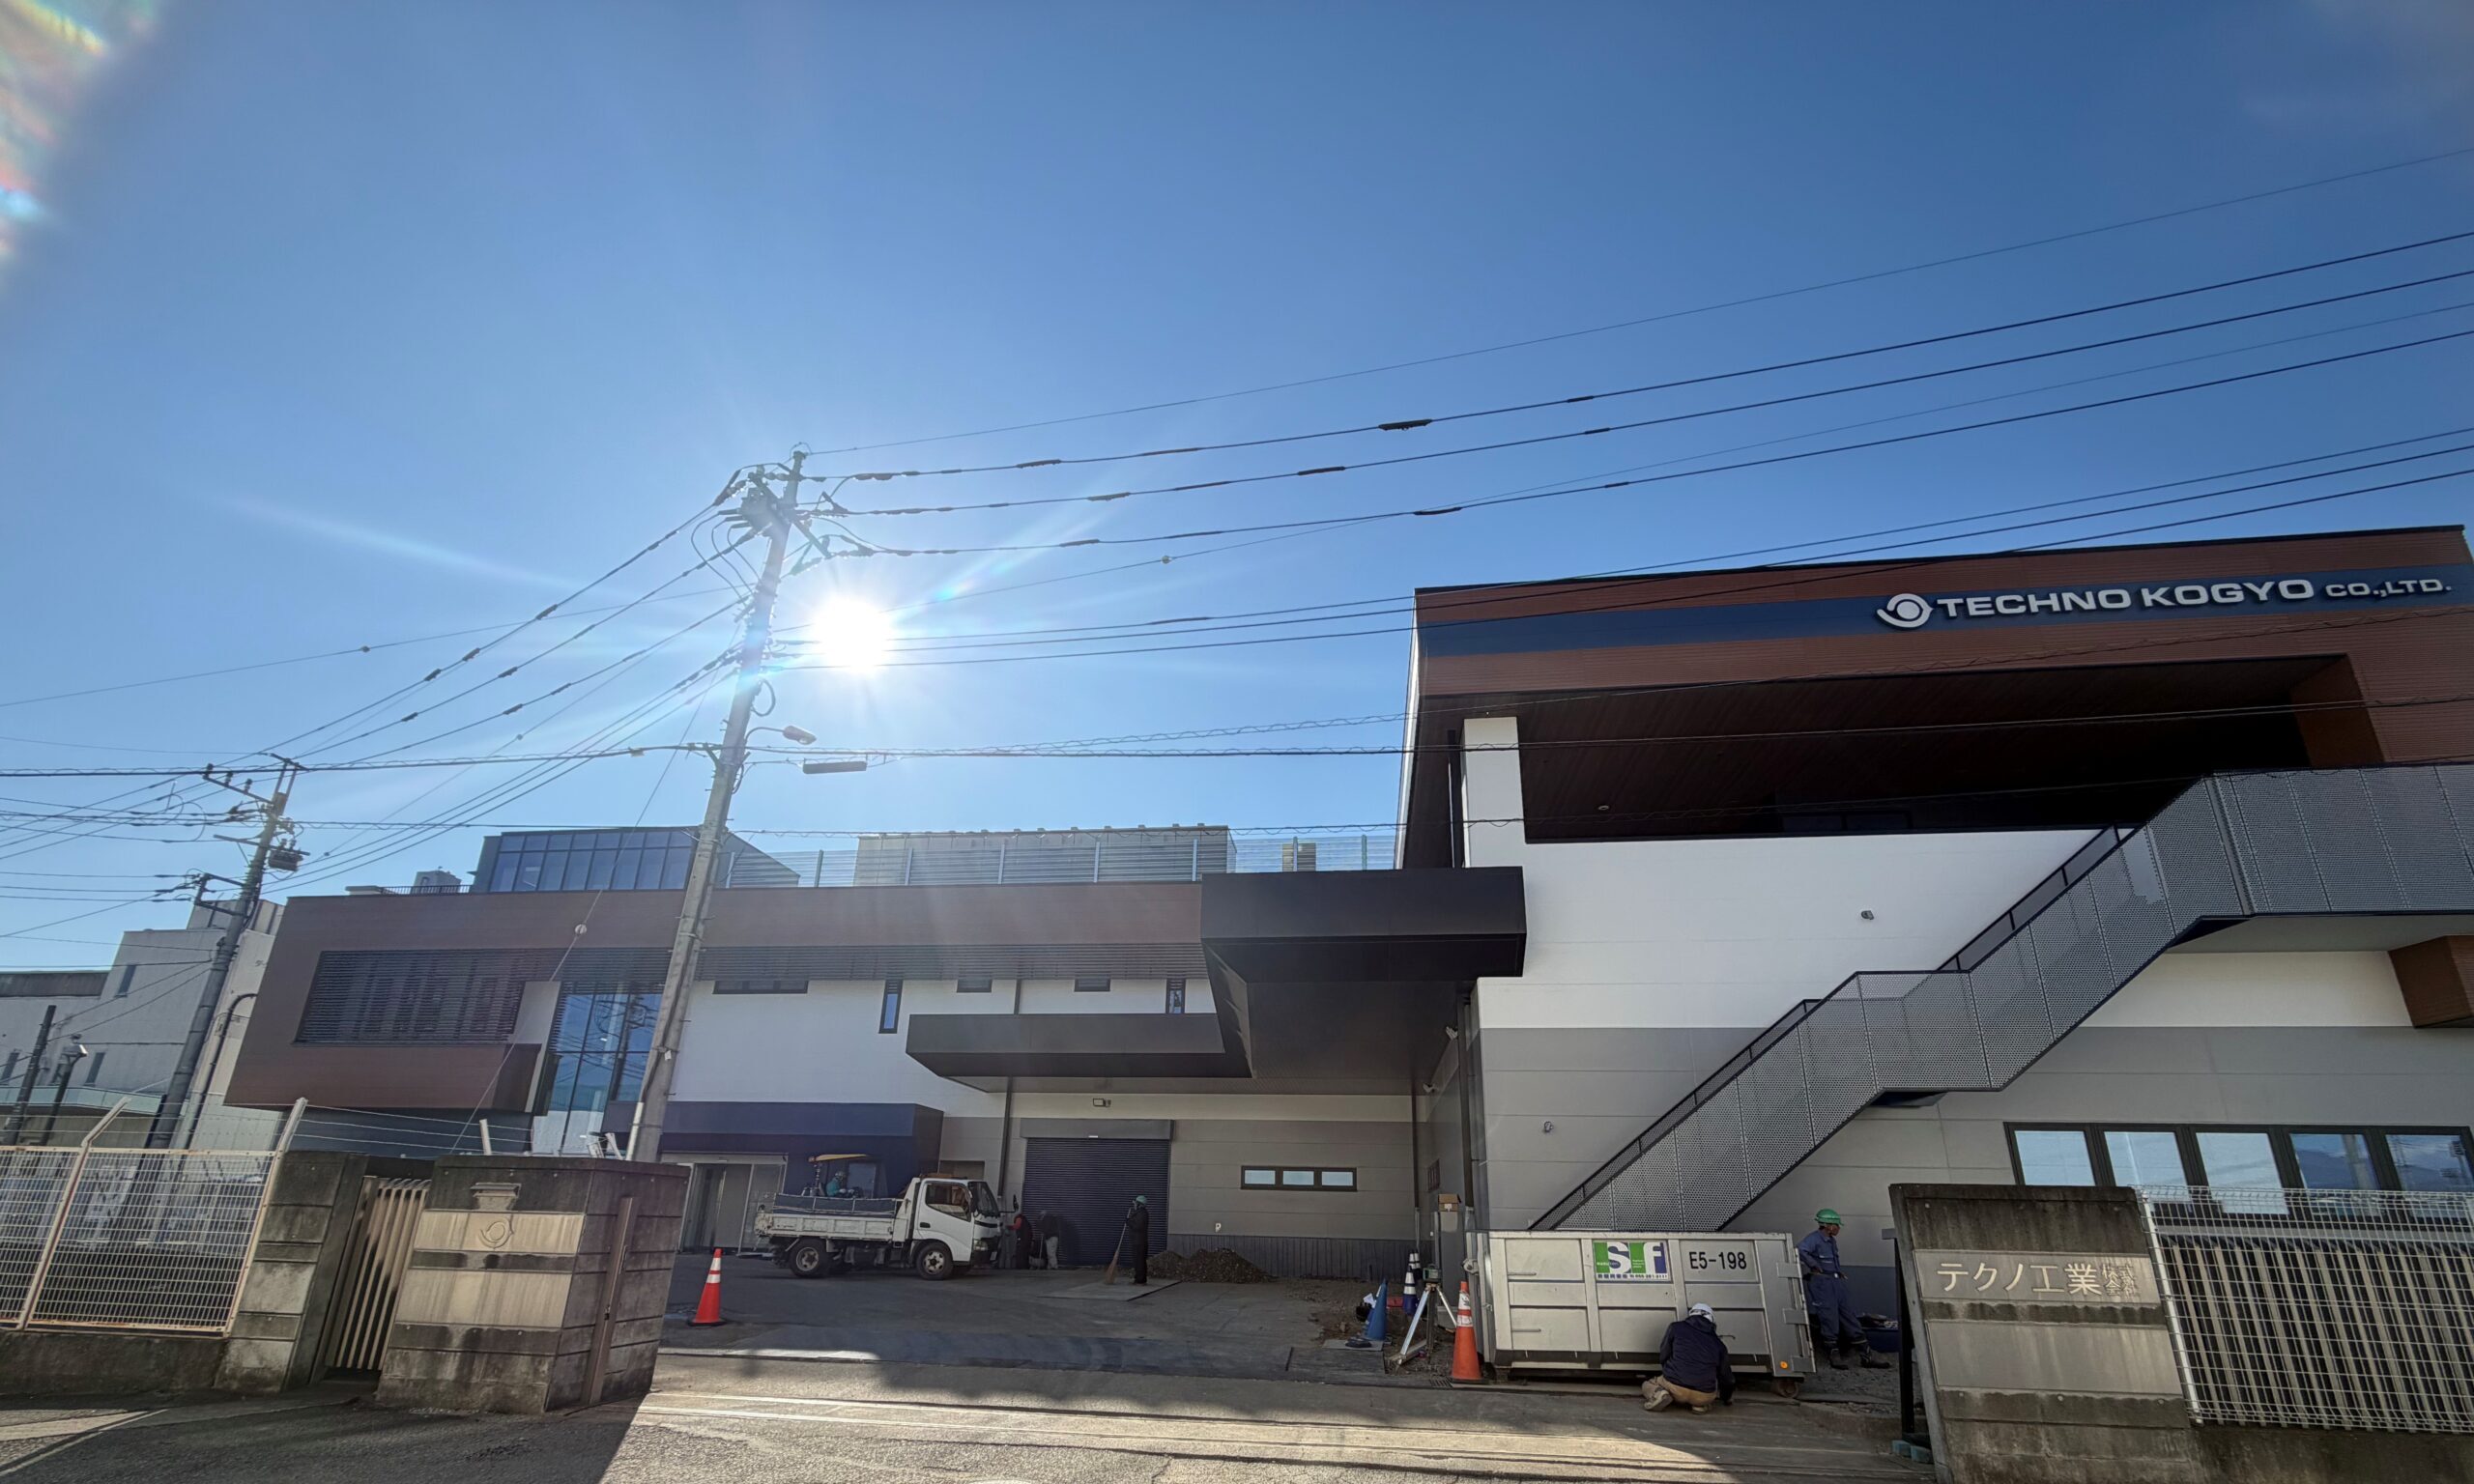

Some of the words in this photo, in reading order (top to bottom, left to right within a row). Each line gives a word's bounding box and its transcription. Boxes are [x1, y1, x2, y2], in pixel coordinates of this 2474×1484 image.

[1937, 588, 2132, 618] TECHNO
[2141, 579, 2316, 608] KOGYO
[2325, 579, 2453, 598] CO.,LTD.
[1688, 1251, 1747, 1270] E5-198
